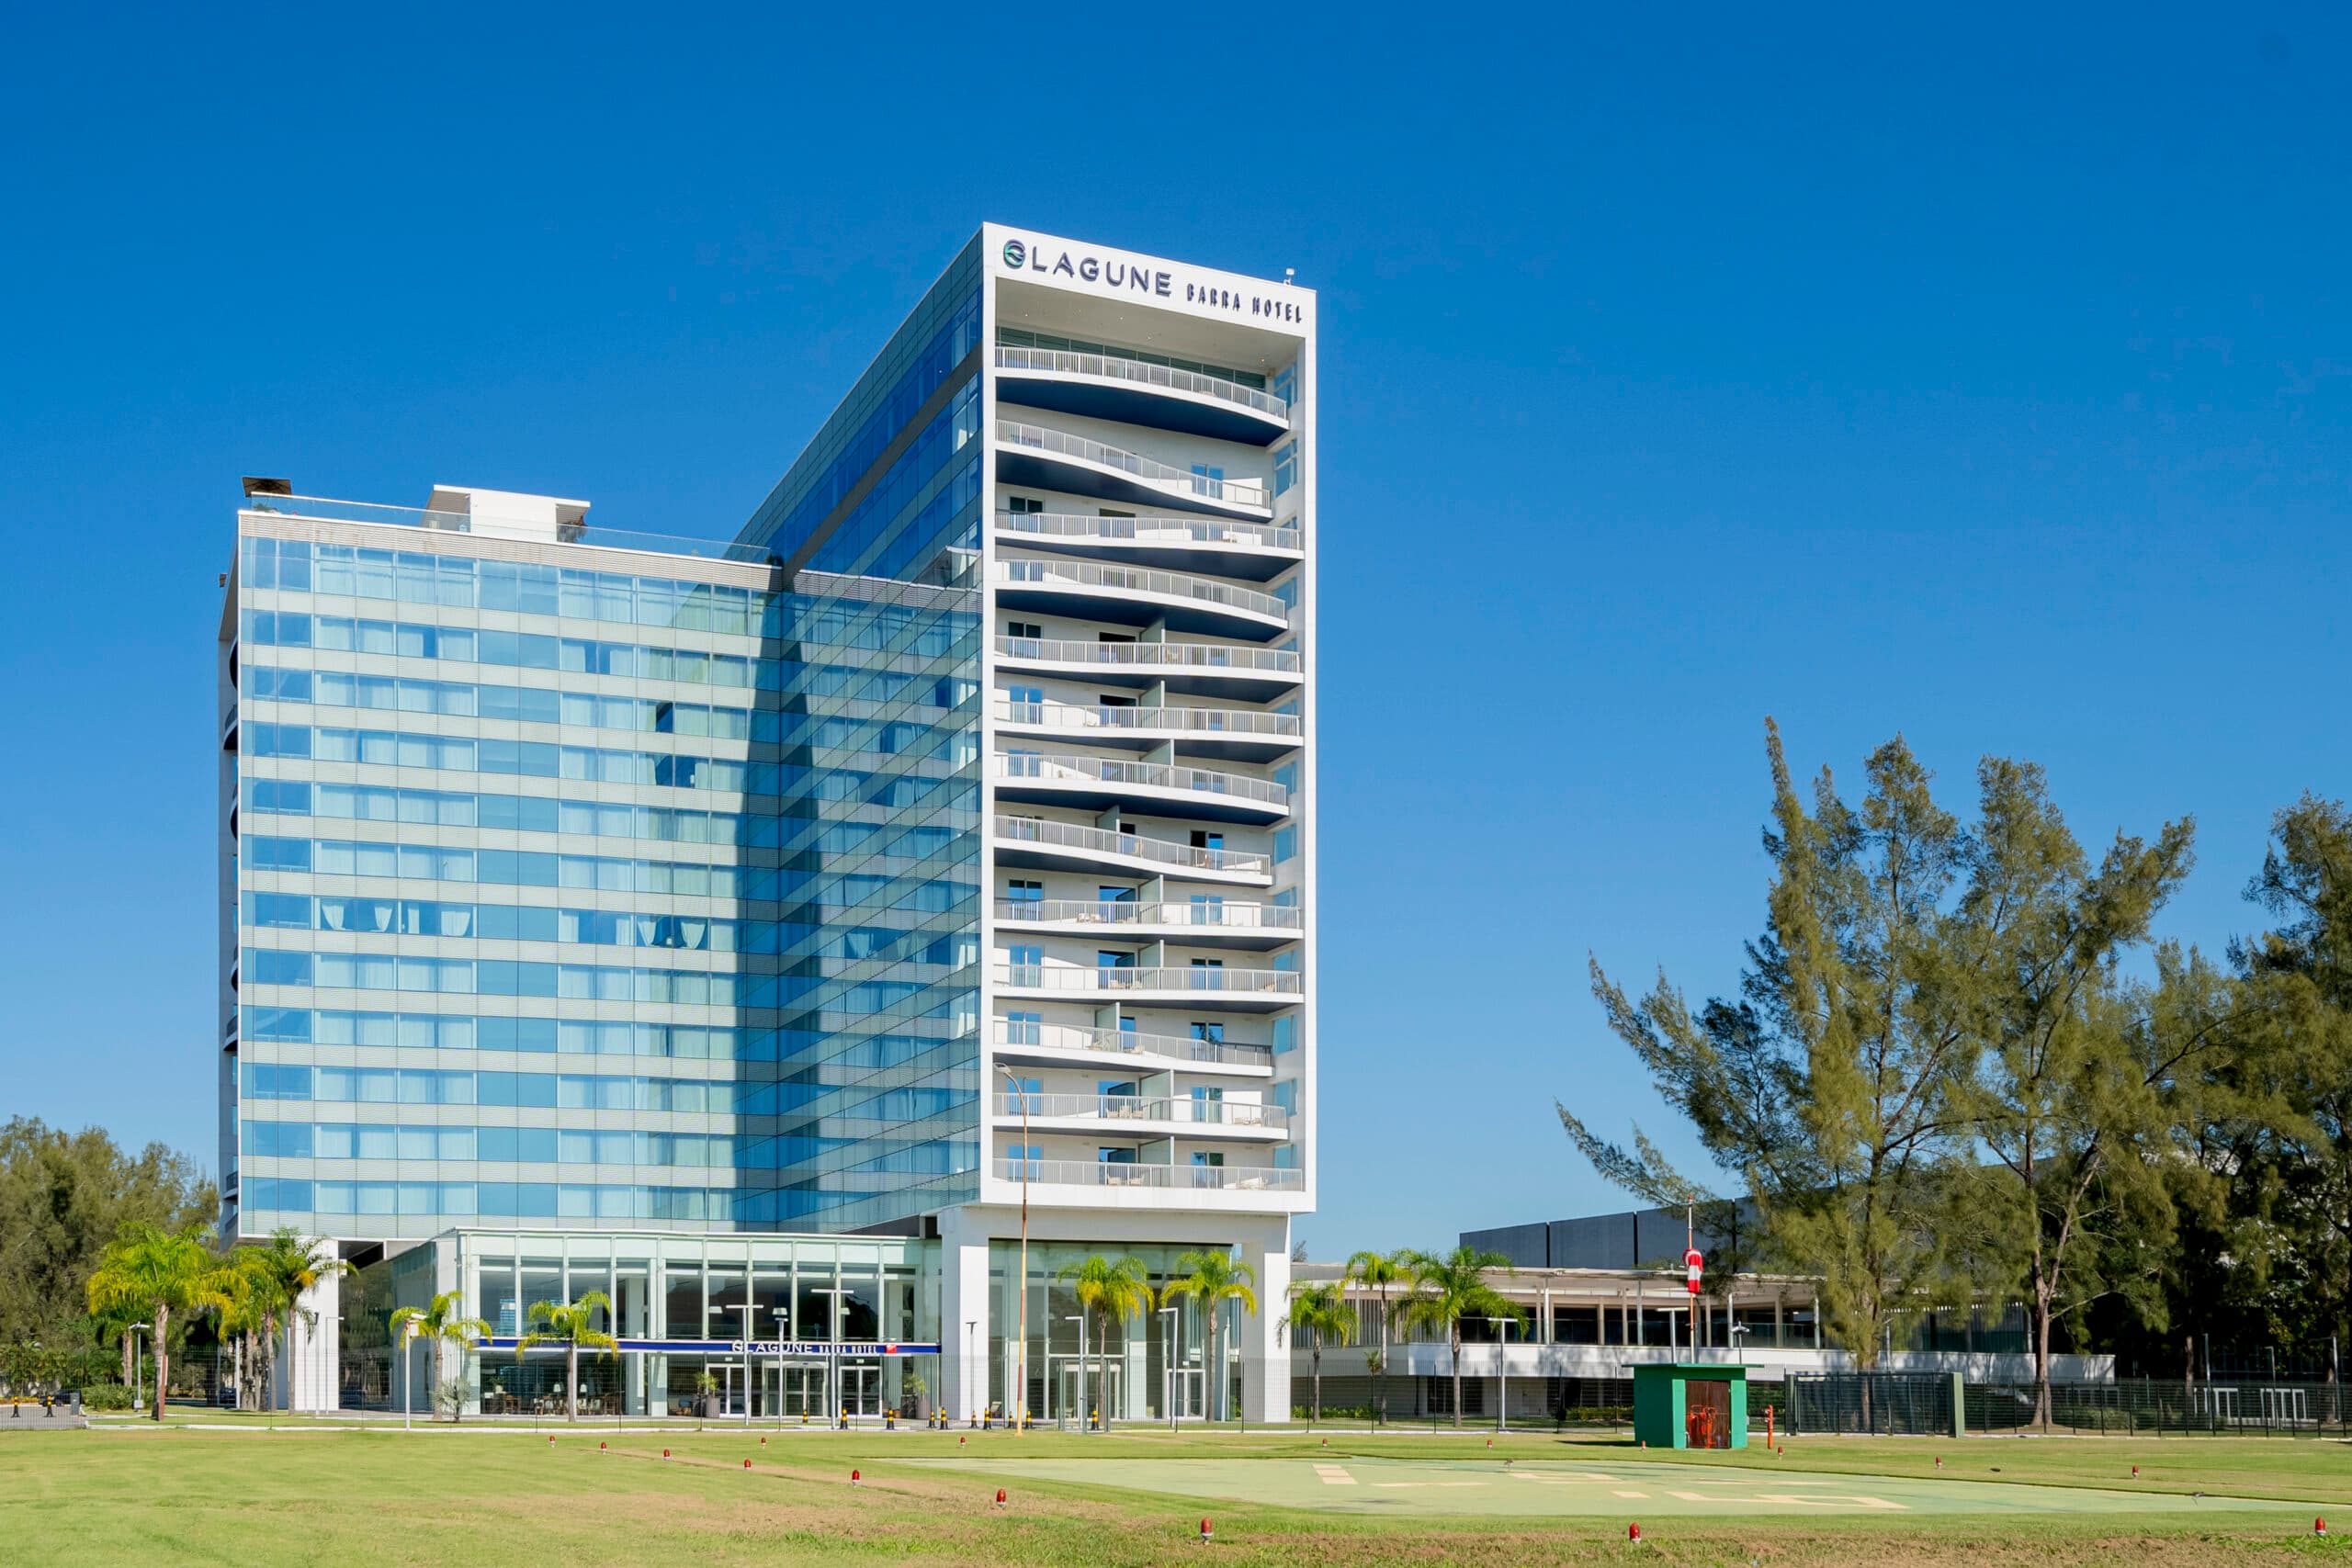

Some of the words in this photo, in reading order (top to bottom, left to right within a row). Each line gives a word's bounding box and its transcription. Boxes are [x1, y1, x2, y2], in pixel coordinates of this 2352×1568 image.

[1186, 283, 1240, 311] BARRA
[1252, 296, 1302, 323] HOTEL
[819, 1345, 847, 1354] BARA
[852, 1345, 876, 1354] HOTEL
